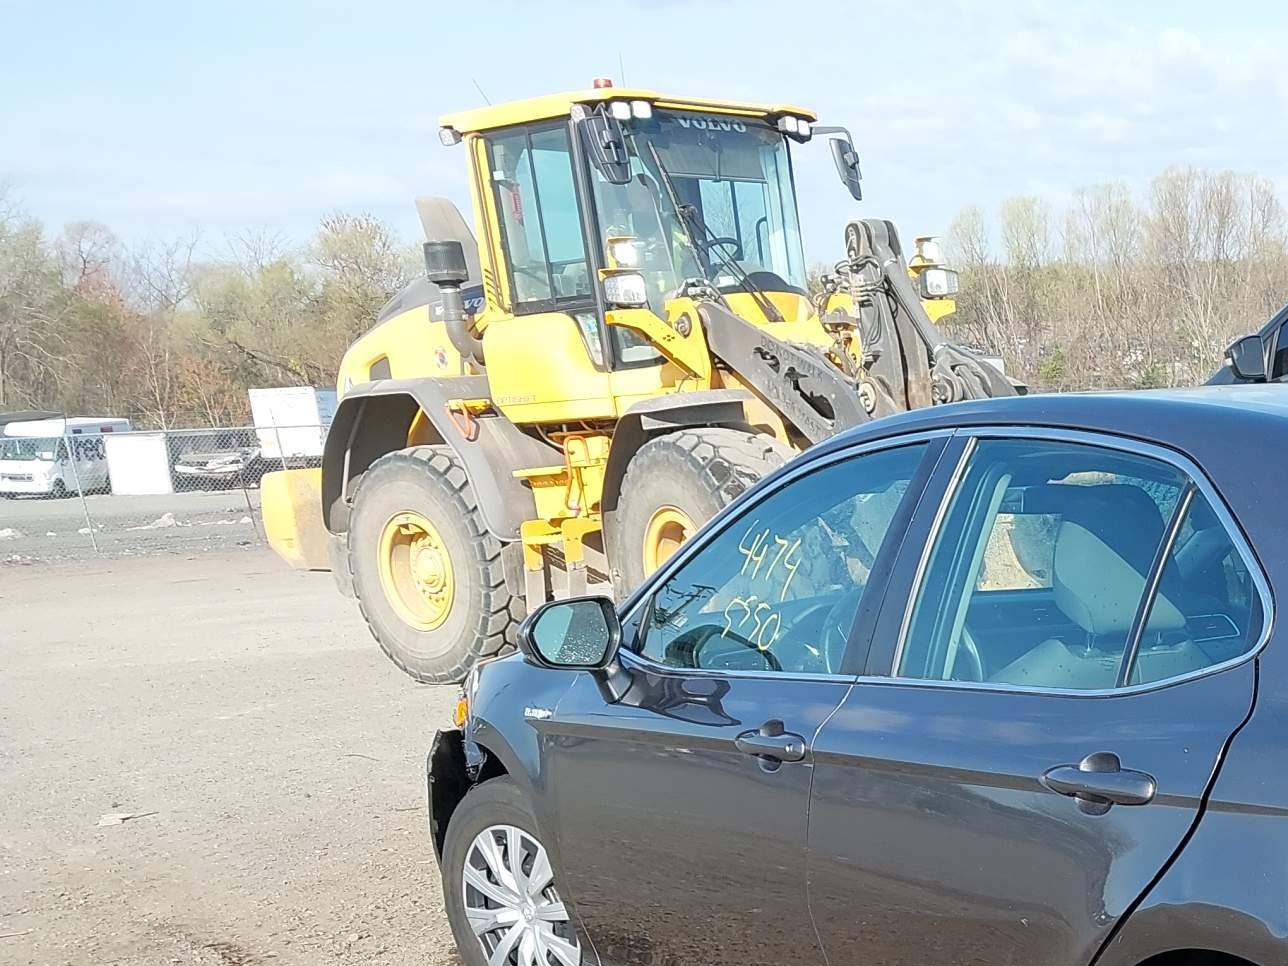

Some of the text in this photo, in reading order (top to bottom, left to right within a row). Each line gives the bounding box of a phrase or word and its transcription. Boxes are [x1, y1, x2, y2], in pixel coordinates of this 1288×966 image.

[678, 116, 747, 133] VOLVO
[738, 519, 802, 602] 4474
[720, 595, 782, 651] 5550
